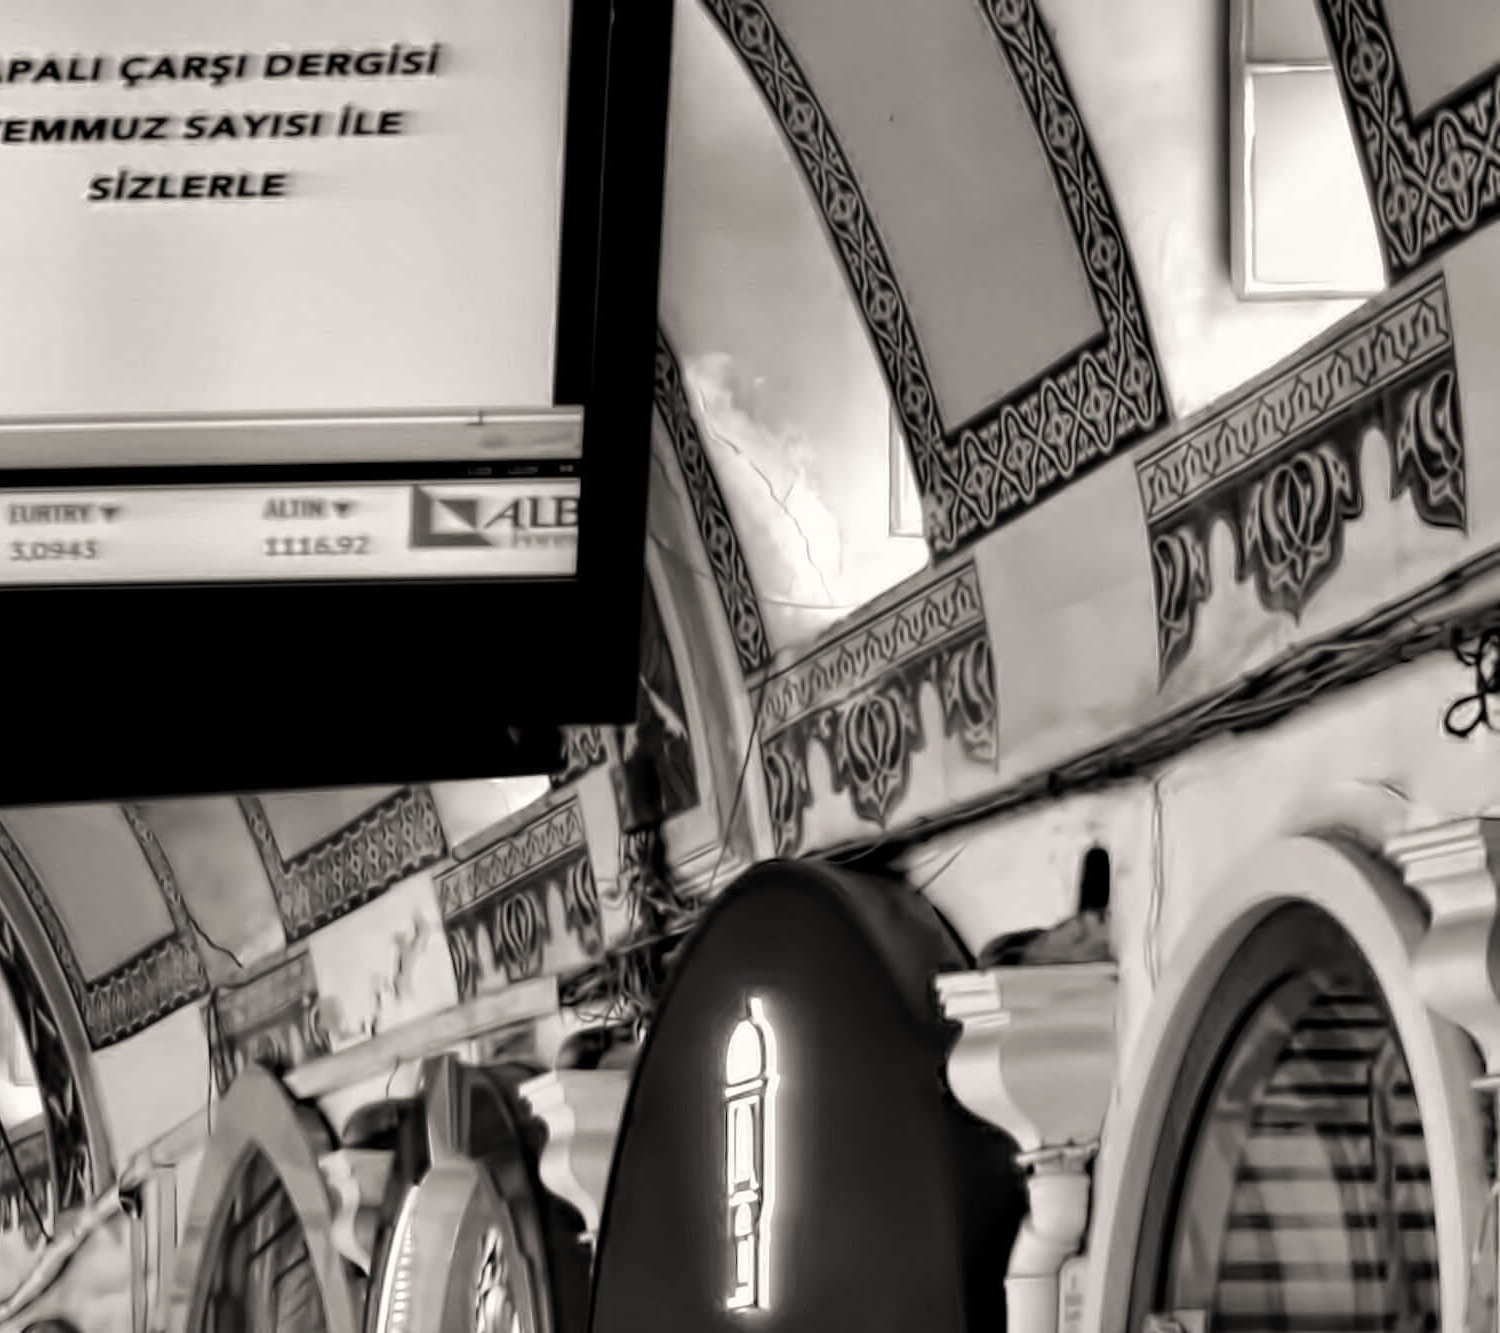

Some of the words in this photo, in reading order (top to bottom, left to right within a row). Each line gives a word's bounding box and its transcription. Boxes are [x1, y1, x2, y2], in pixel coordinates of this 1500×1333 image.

[118, 53, 248, 88] ÇARŞI
[263, 42, 442, 78] DERGİSİ
[183, 111, 324, 140] SAYISI
[337, 100, 404, 136] İLE
[87, 168, 287, 201] SİZLERLE
